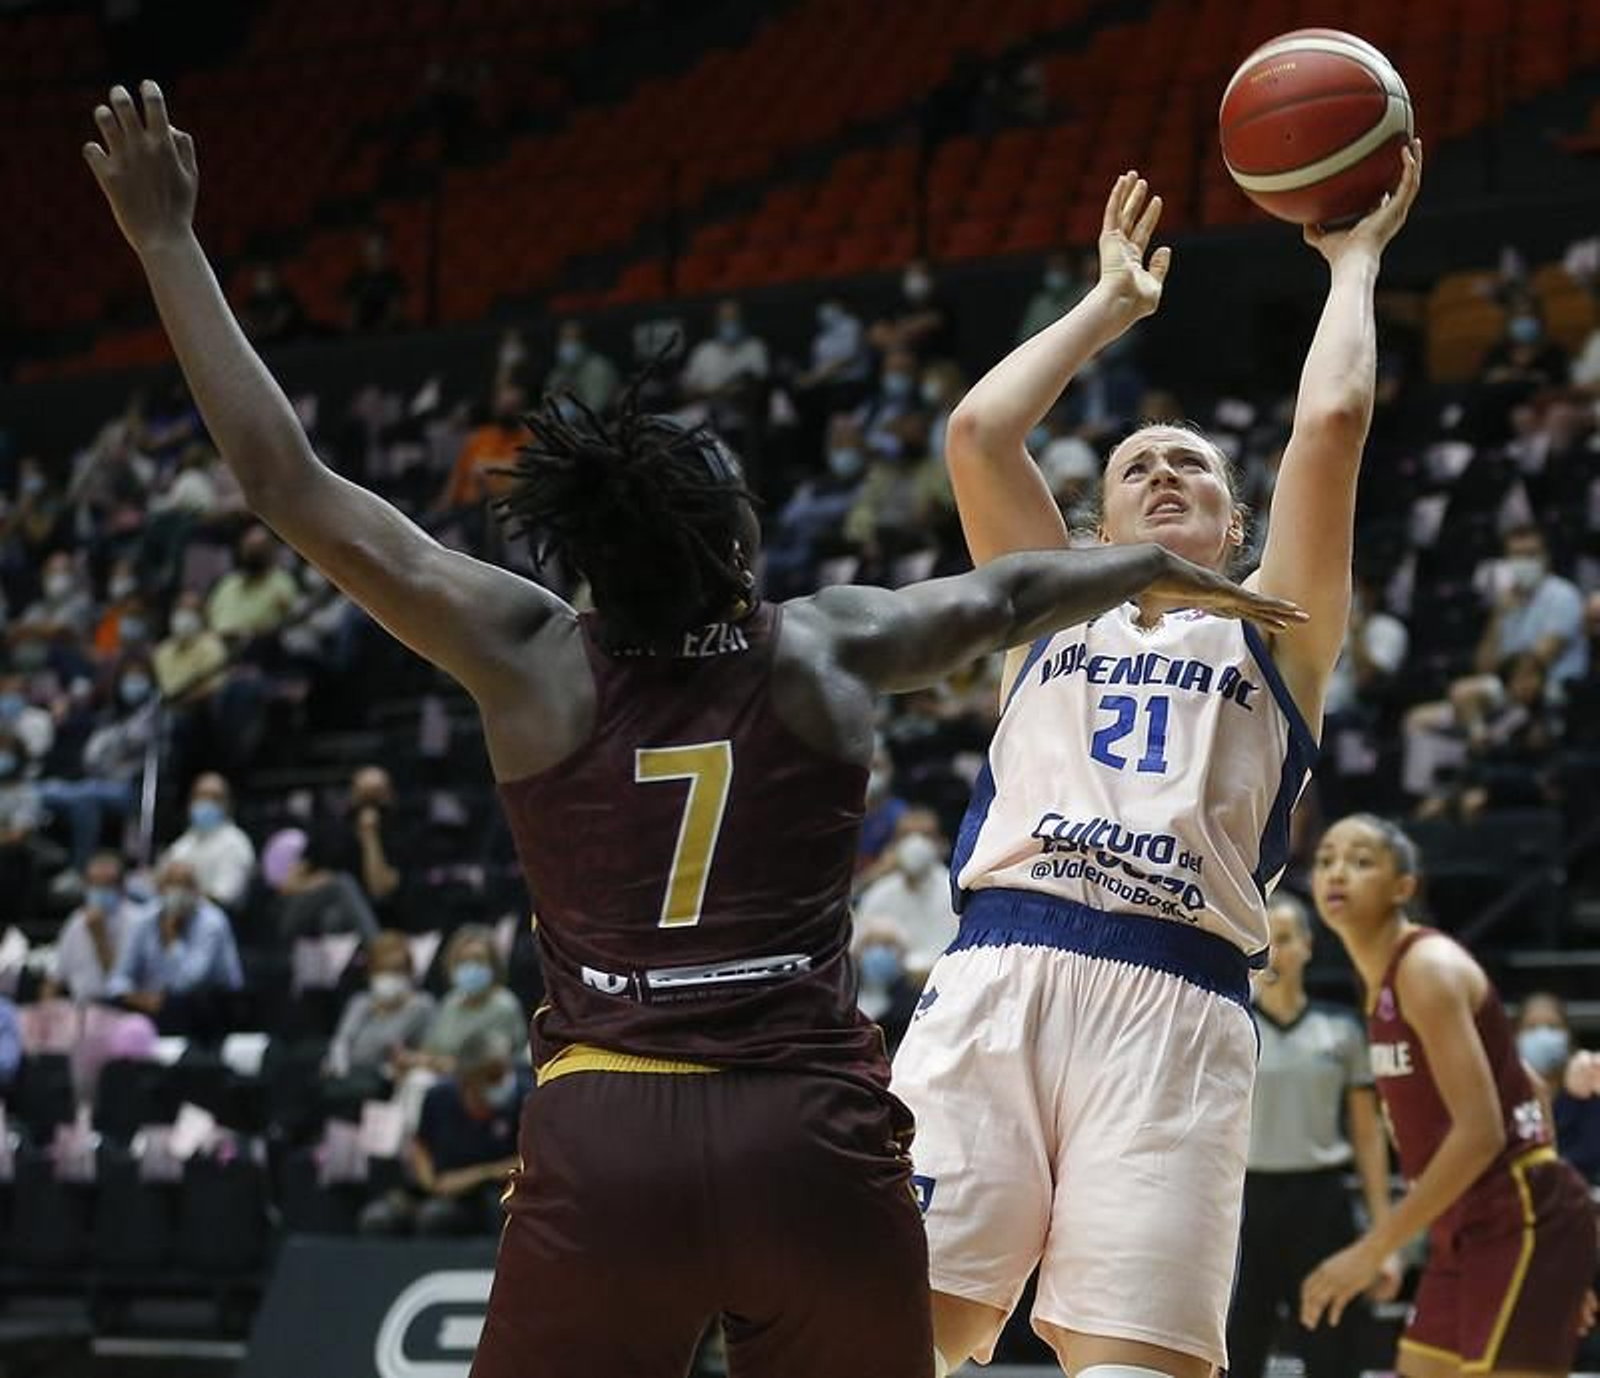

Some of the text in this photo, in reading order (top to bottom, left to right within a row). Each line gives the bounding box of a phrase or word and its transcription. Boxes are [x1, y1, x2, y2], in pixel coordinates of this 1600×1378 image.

[1040, 643, 1214, 694] VALENCIA
[1091, 695, 1169, 774] 21
[634, 739, 734, 929] 7
[1031, 813, 1203, 874] Cultura del
